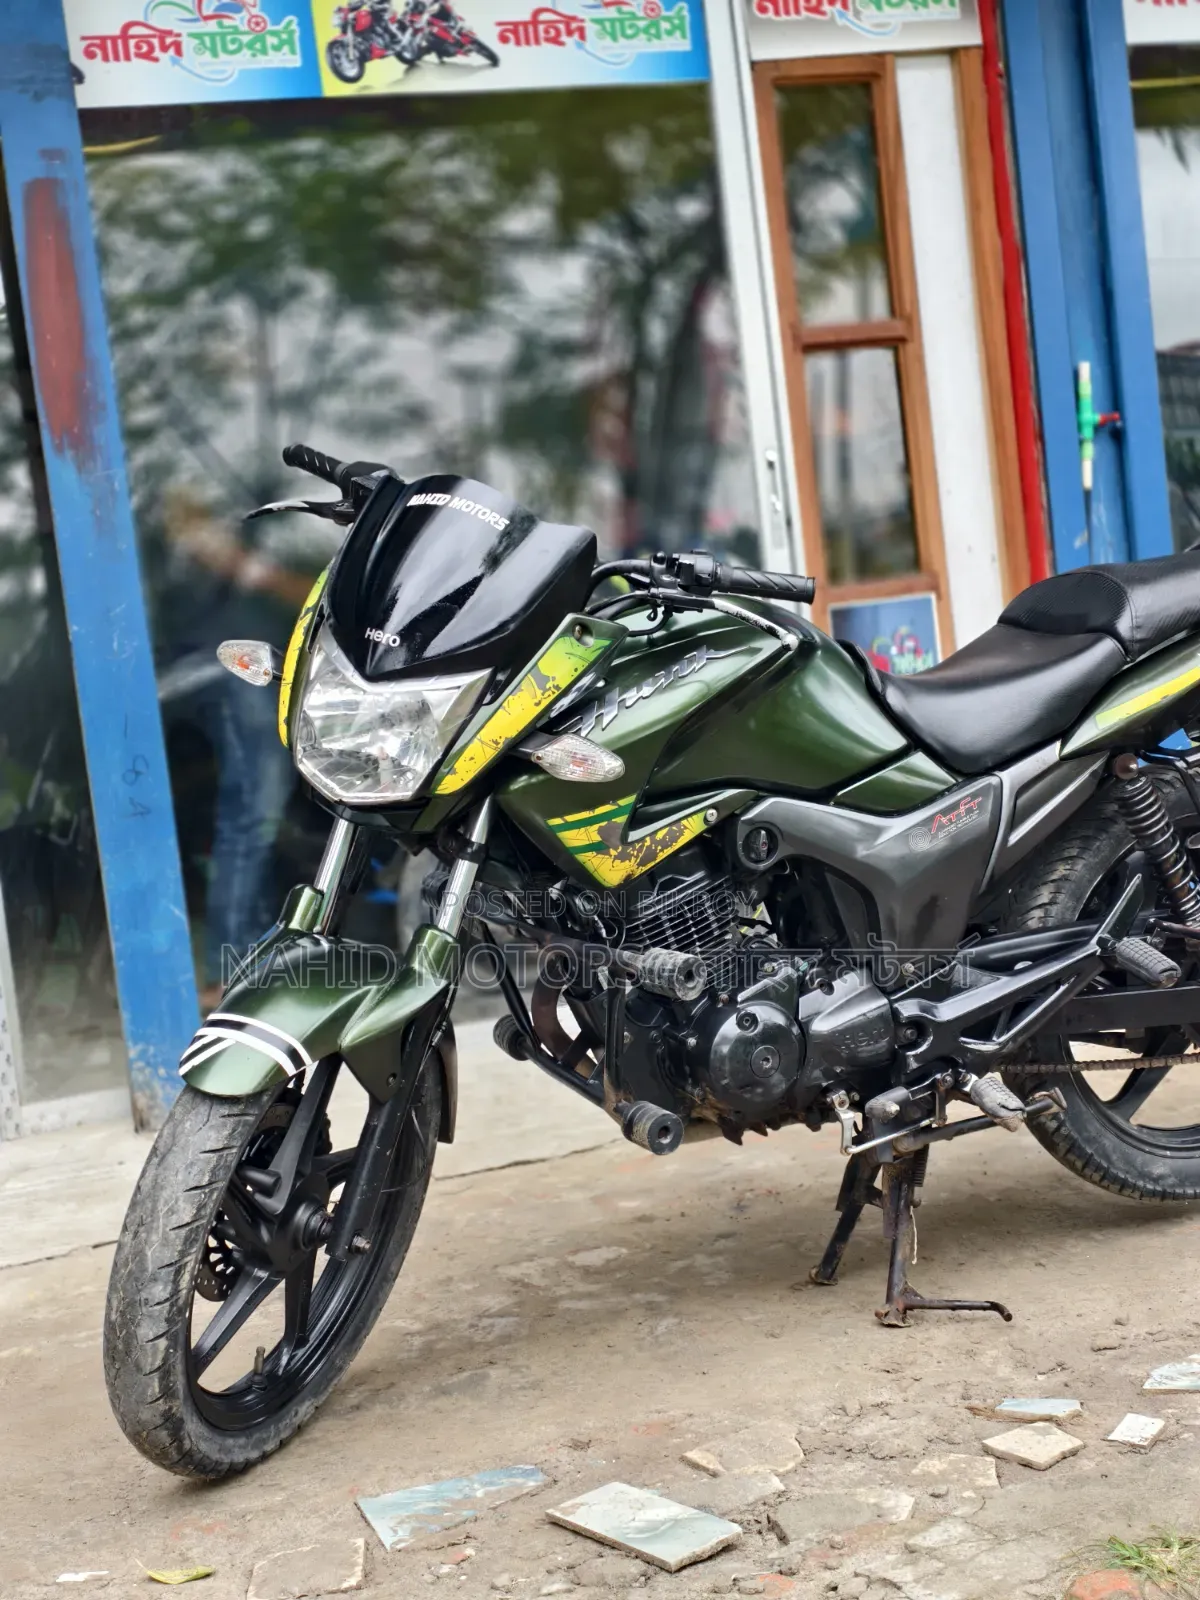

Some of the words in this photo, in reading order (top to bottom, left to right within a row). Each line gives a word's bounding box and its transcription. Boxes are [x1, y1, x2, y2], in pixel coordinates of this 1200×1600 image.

[80, 20, 184, 63] নাহিদ
[495, 7, 586, 46] নাহিদ
[406, 493, 452, 507] NAHID
[448, 497, 510, 531] MOTORS
[364, 627, 401, 647] Hero
